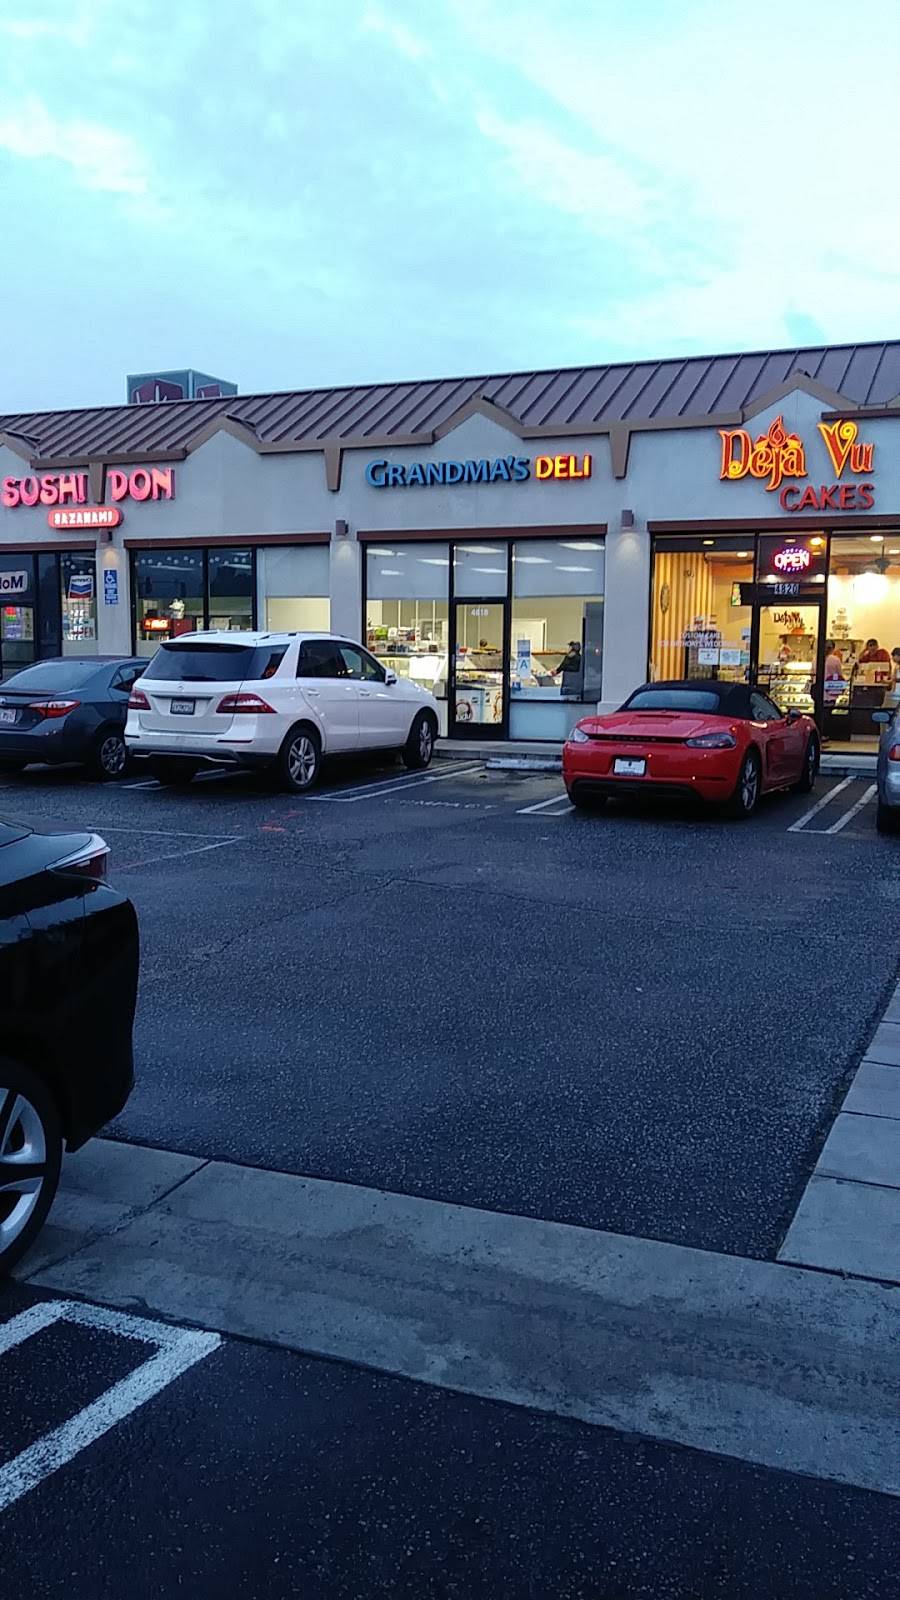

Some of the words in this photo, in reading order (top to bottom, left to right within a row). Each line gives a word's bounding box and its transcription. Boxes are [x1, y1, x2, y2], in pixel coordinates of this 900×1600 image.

[817, 419, 874, 479] Vu
[365, 456, 530, 487] GRANDMA'S
[534, 454, 592, 479] DELI
[2, 472, 88, 507] SUSHI
[107, 466, 175, 502] DON
[780, 483, 875, 511] CAKES
[54, 511, 113, 525] SAZANAMI
[774, 552, 810, 568] OPEN
[774, 583, 799, 594] 4820
[520, 659, 528, 669] A
